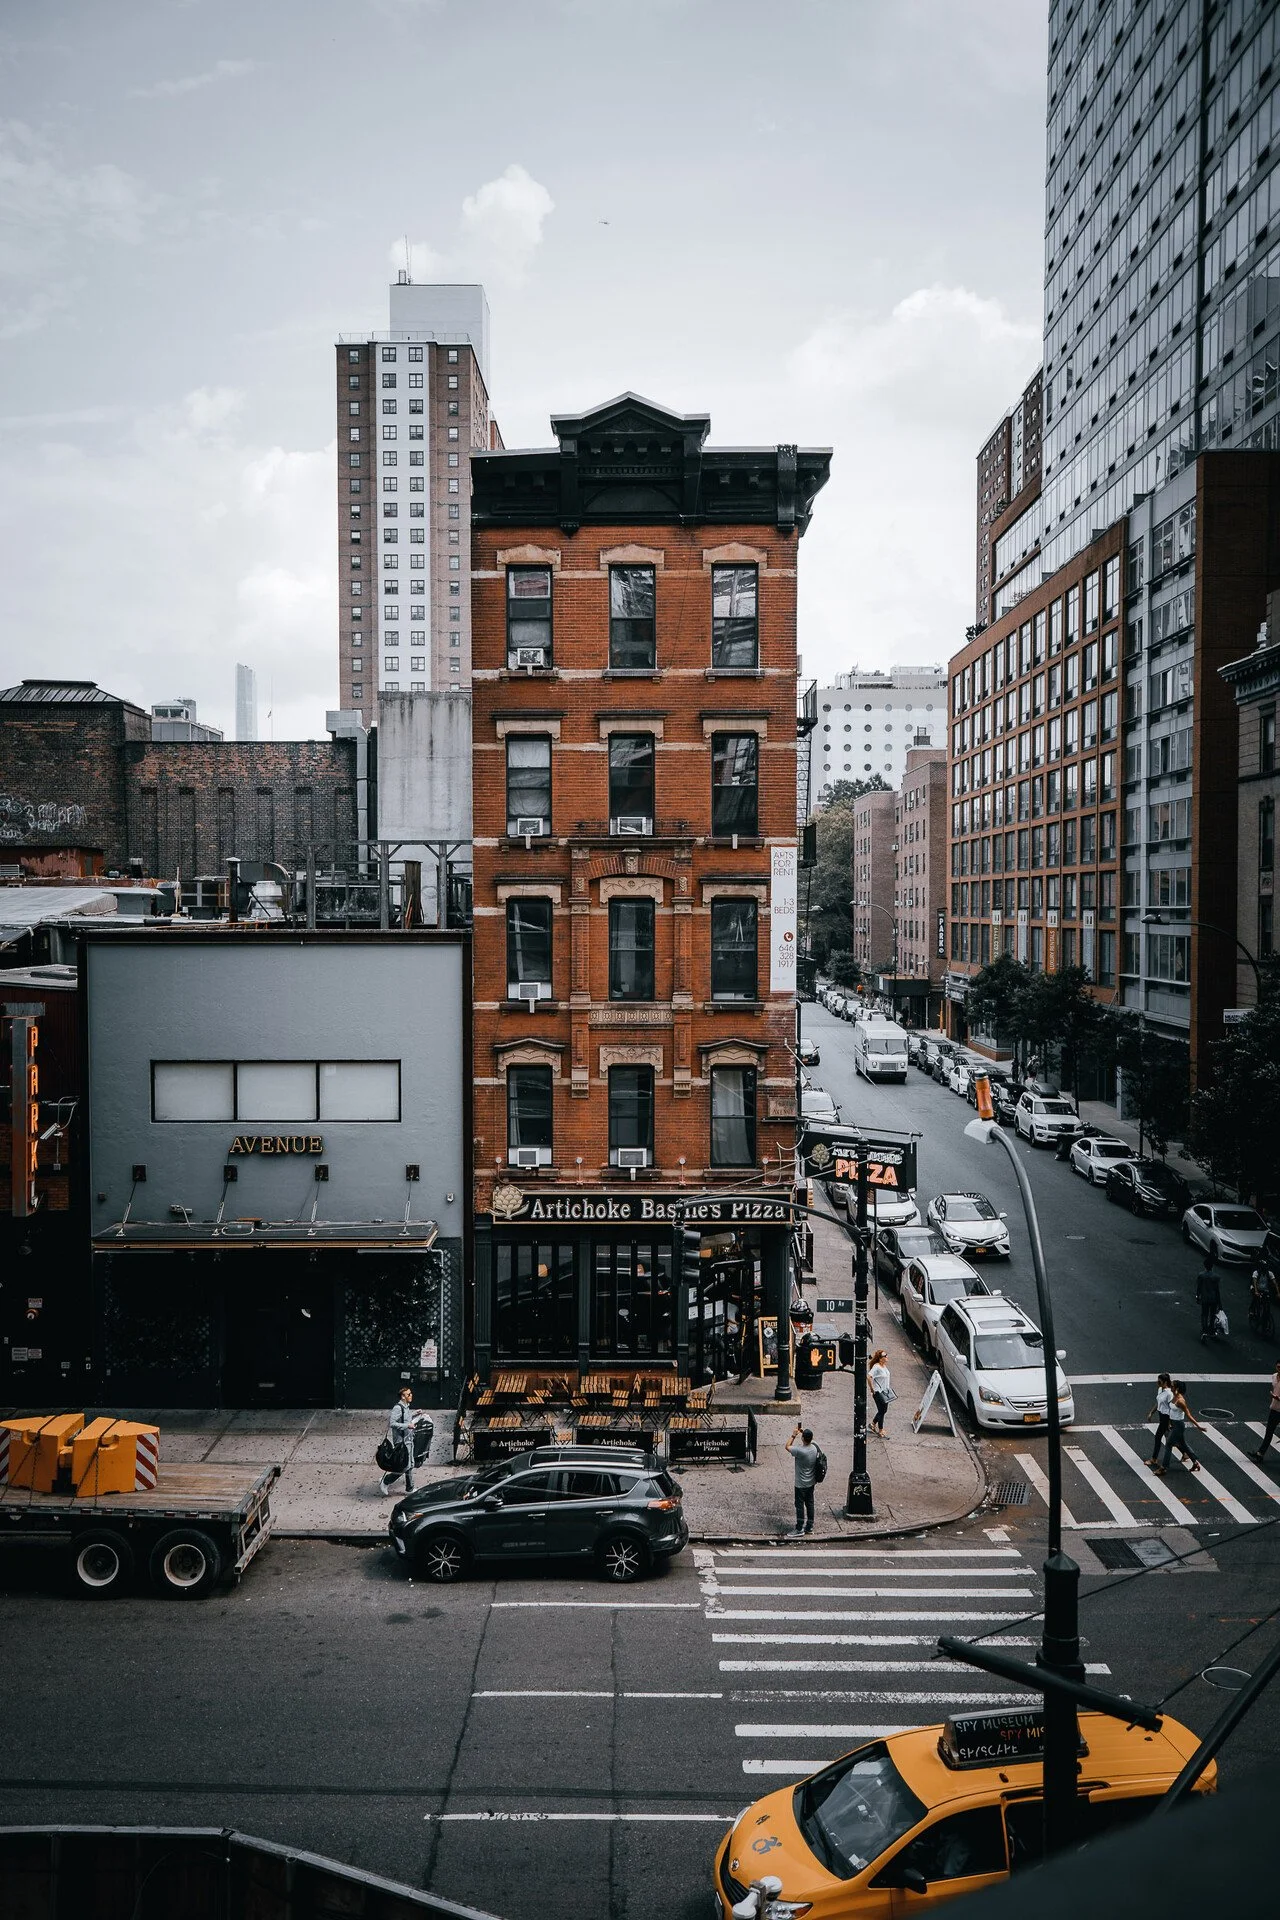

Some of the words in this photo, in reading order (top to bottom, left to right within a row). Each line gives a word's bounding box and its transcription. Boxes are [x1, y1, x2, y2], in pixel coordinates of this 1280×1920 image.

[773, 860, 791, 868] FOR
[773, 868, 795, 876] RENT
[783, 898, 795, 906] 1-3
[774, 906, 795, 914] BEDS
[778, 944, 795, 952] 646
[779, 952, 795, 960] 328
[778, 960, 795, 968] 1917
[29, 1025, 39, 1173] PARK
[229, 1136, 323, 1153] AVENUE
[530, 1198, 631, 1219] Artichoke
[825, 1300, 836, 1311] 10
[827, 1349, 834, 1365] 9
[601, 1438, 637, 1446] Artichoke
[982, 1714, 1034, 1731] MUSEUM
